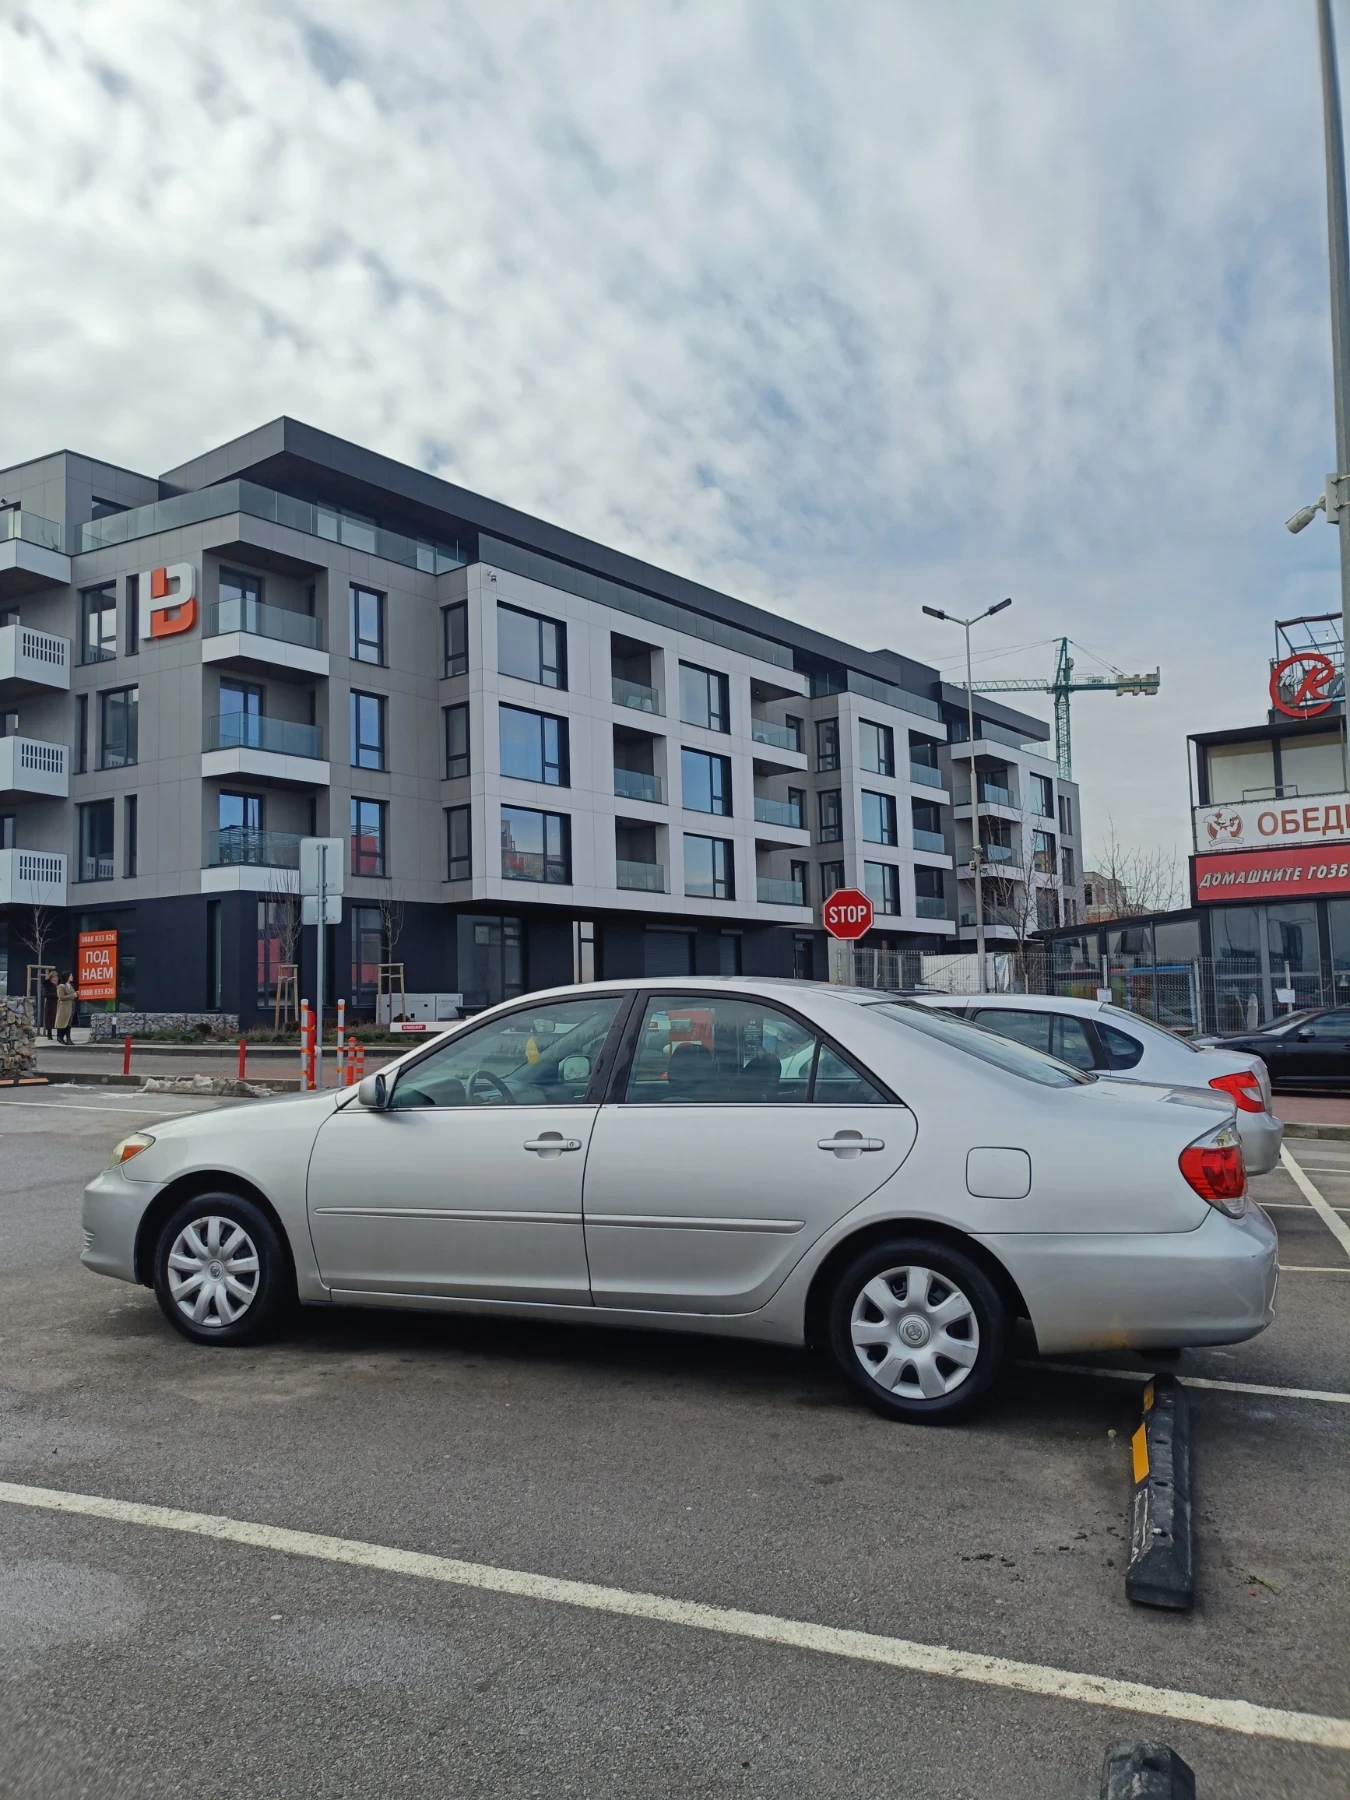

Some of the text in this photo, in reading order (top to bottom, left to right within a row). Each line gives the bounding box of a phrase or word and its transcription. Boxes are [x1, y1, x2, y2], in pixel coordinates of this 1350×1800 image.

[1199, 863, 1350, 889] ДОМАШНИТЕ ГОЗБ
[828, 905, 867, 924] STOP
[86, 950, 110, 965] ПОД
[82, 967, 113, 980] НАЕМ
